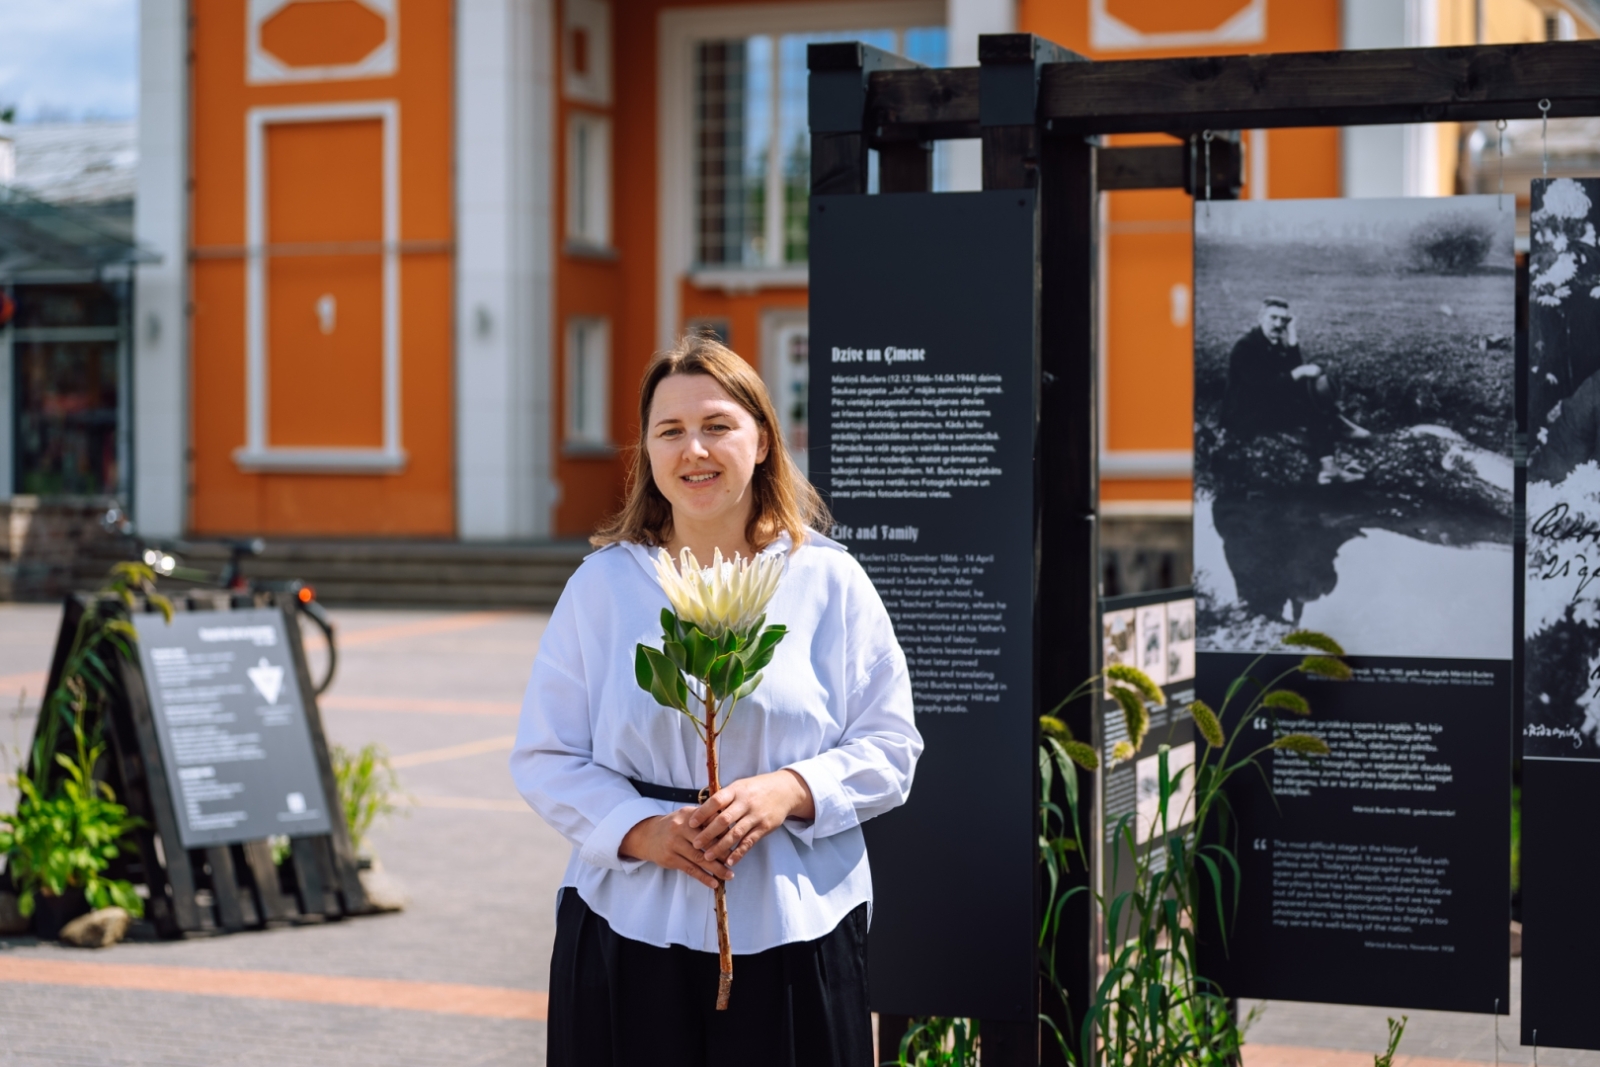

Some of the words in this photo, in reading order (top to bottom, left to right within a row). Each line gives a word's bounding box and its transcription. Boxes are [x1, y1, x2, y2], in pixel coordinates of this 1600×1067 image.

[856, 525, 878, 540] and
[901, 552, 938, 562] December
[966, 554, 974, 562] 14
[976, 554, 994, 565] April
[887, 564, 901, 572] into
[939, 565, 960, 576] family
[972, 565, 984, 574] the
[891, 587, 902, 596] the
[904, 587, 920, 596] local
[923, 588, 944, 599] parish
[974, 588, 983, 597] he
[972, 600, 995, 609] where
[997, 600, 1006, 609] he
[917, 622, 926, 631] he
[940, 669, 954, 677] and
[974, 681, 1000, 690] buried
[985, 693, 999, 701] and
